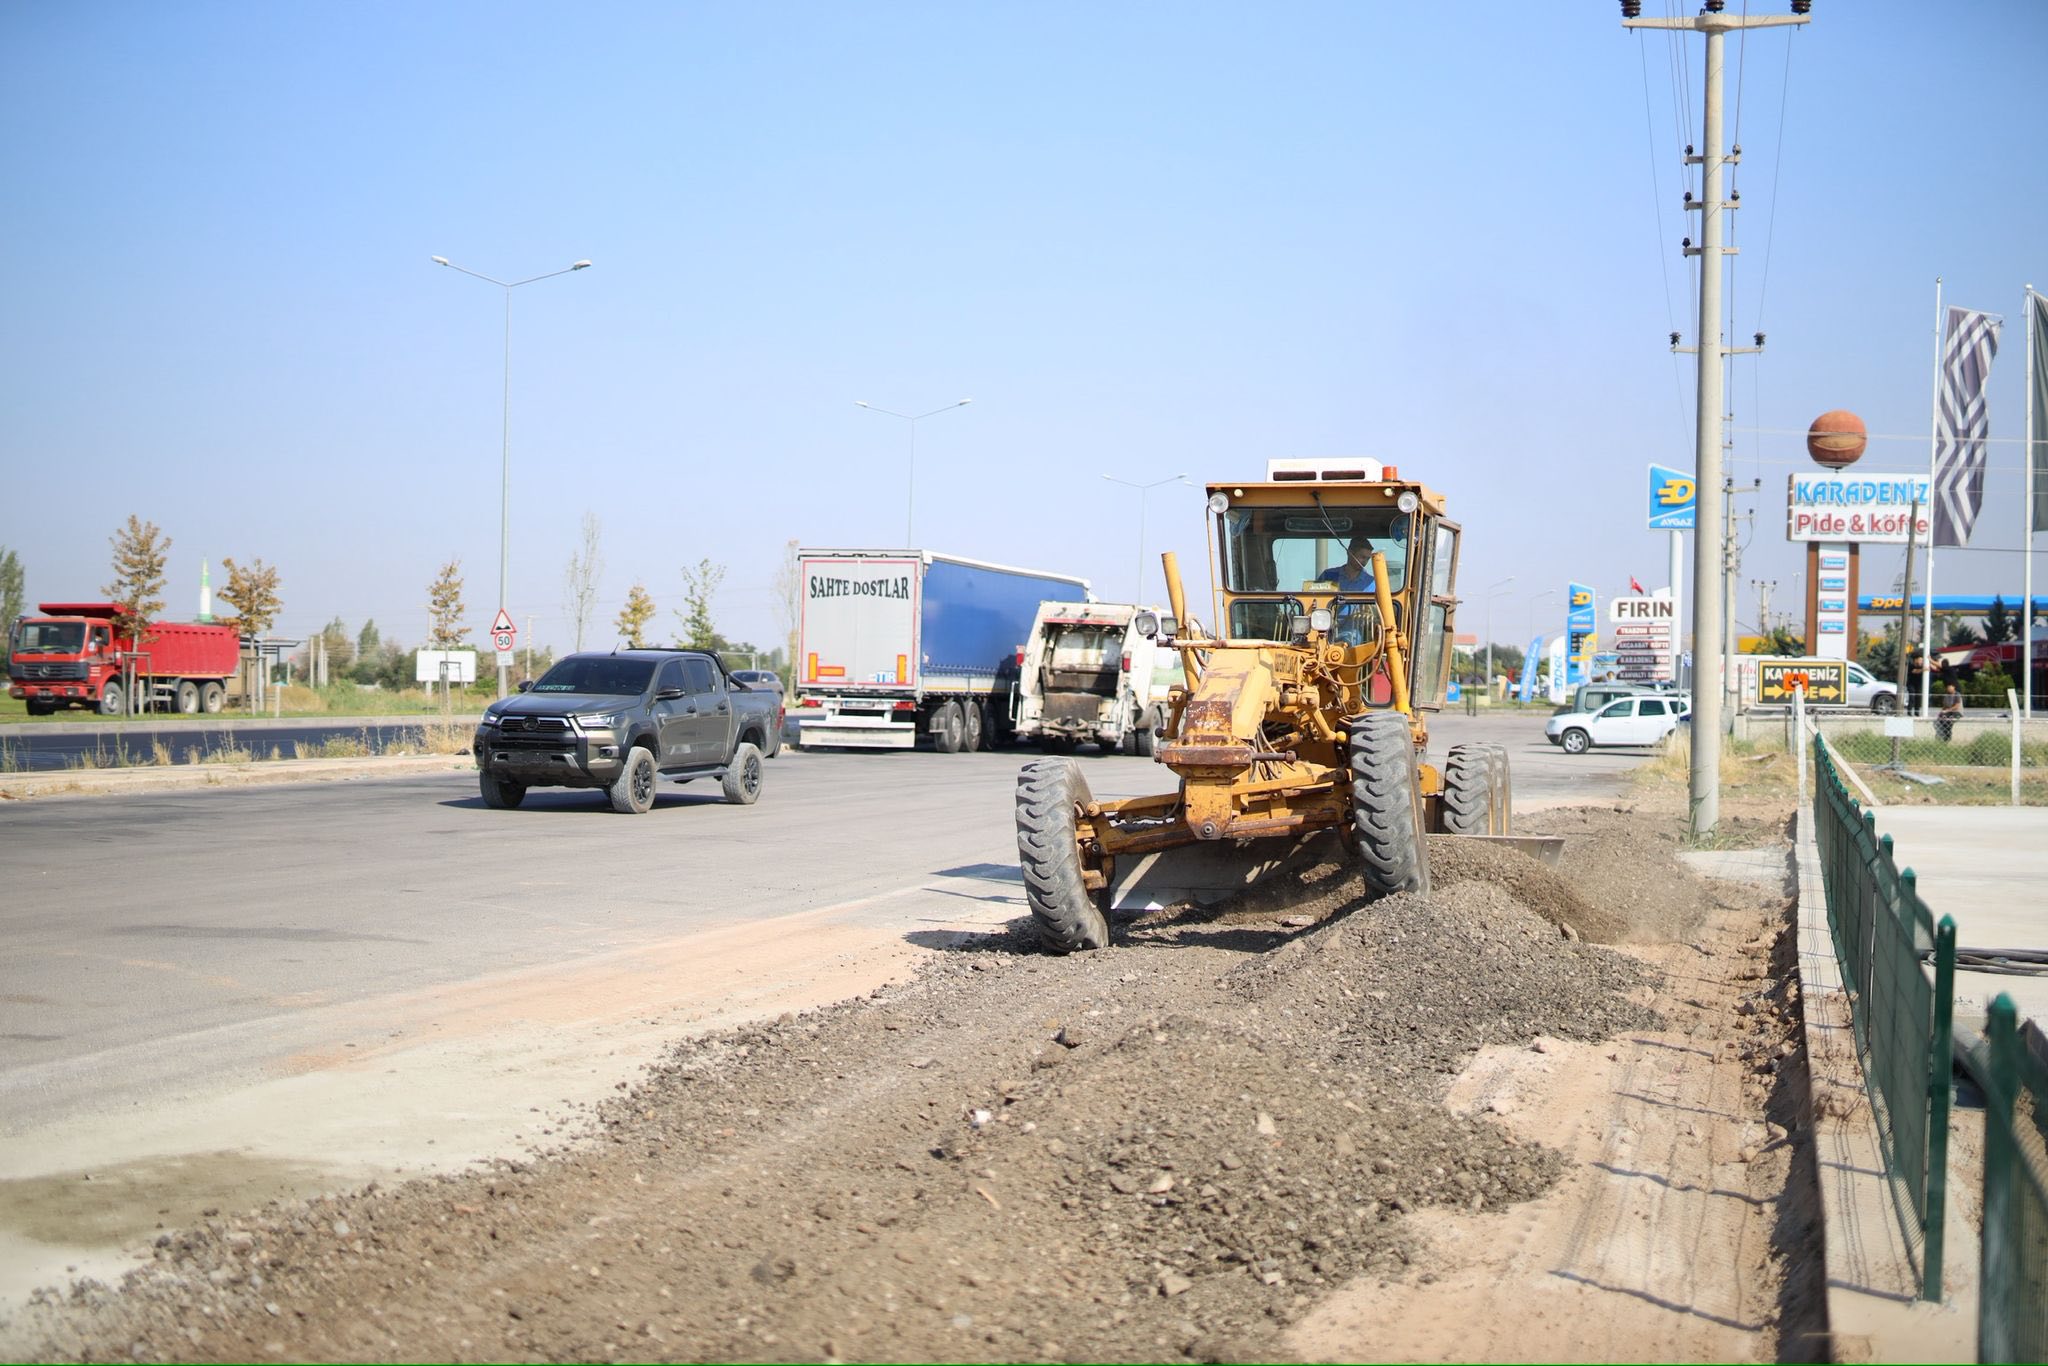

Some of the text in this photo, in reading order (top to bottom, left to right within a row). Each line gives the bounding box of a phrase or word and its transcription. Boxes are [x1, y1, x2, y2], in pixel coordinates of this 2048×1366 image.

[1796, 480, 1928, 505] KARADENİZ
[1796, 513, 1845, 533] Pide
[1850, 514, 1865, 532] &
[810, 575, 909, 599] SAHTE DOSTLAR
[1617, 602, 1673, 618] FIRIN
[498, 636, 510, 646] 50
